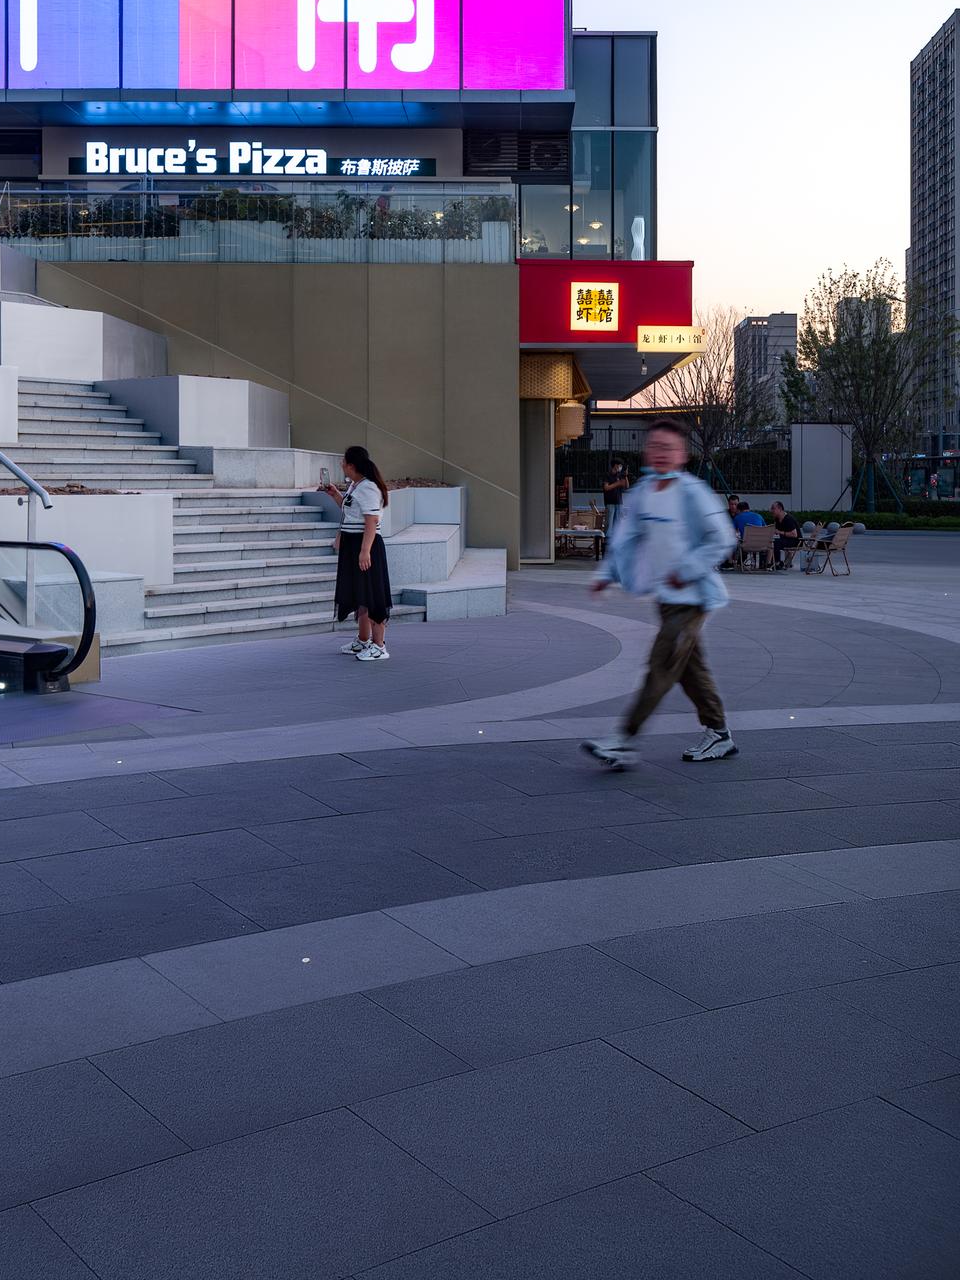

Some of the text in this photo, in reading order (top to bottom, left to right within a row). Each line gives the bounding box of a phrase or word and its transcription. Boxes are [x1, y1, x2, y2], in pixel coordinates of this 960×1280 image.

[86, 139, 327, 174] Bruce's Pizza
[340, 158, 420, 176] 布鲁斯披萨
